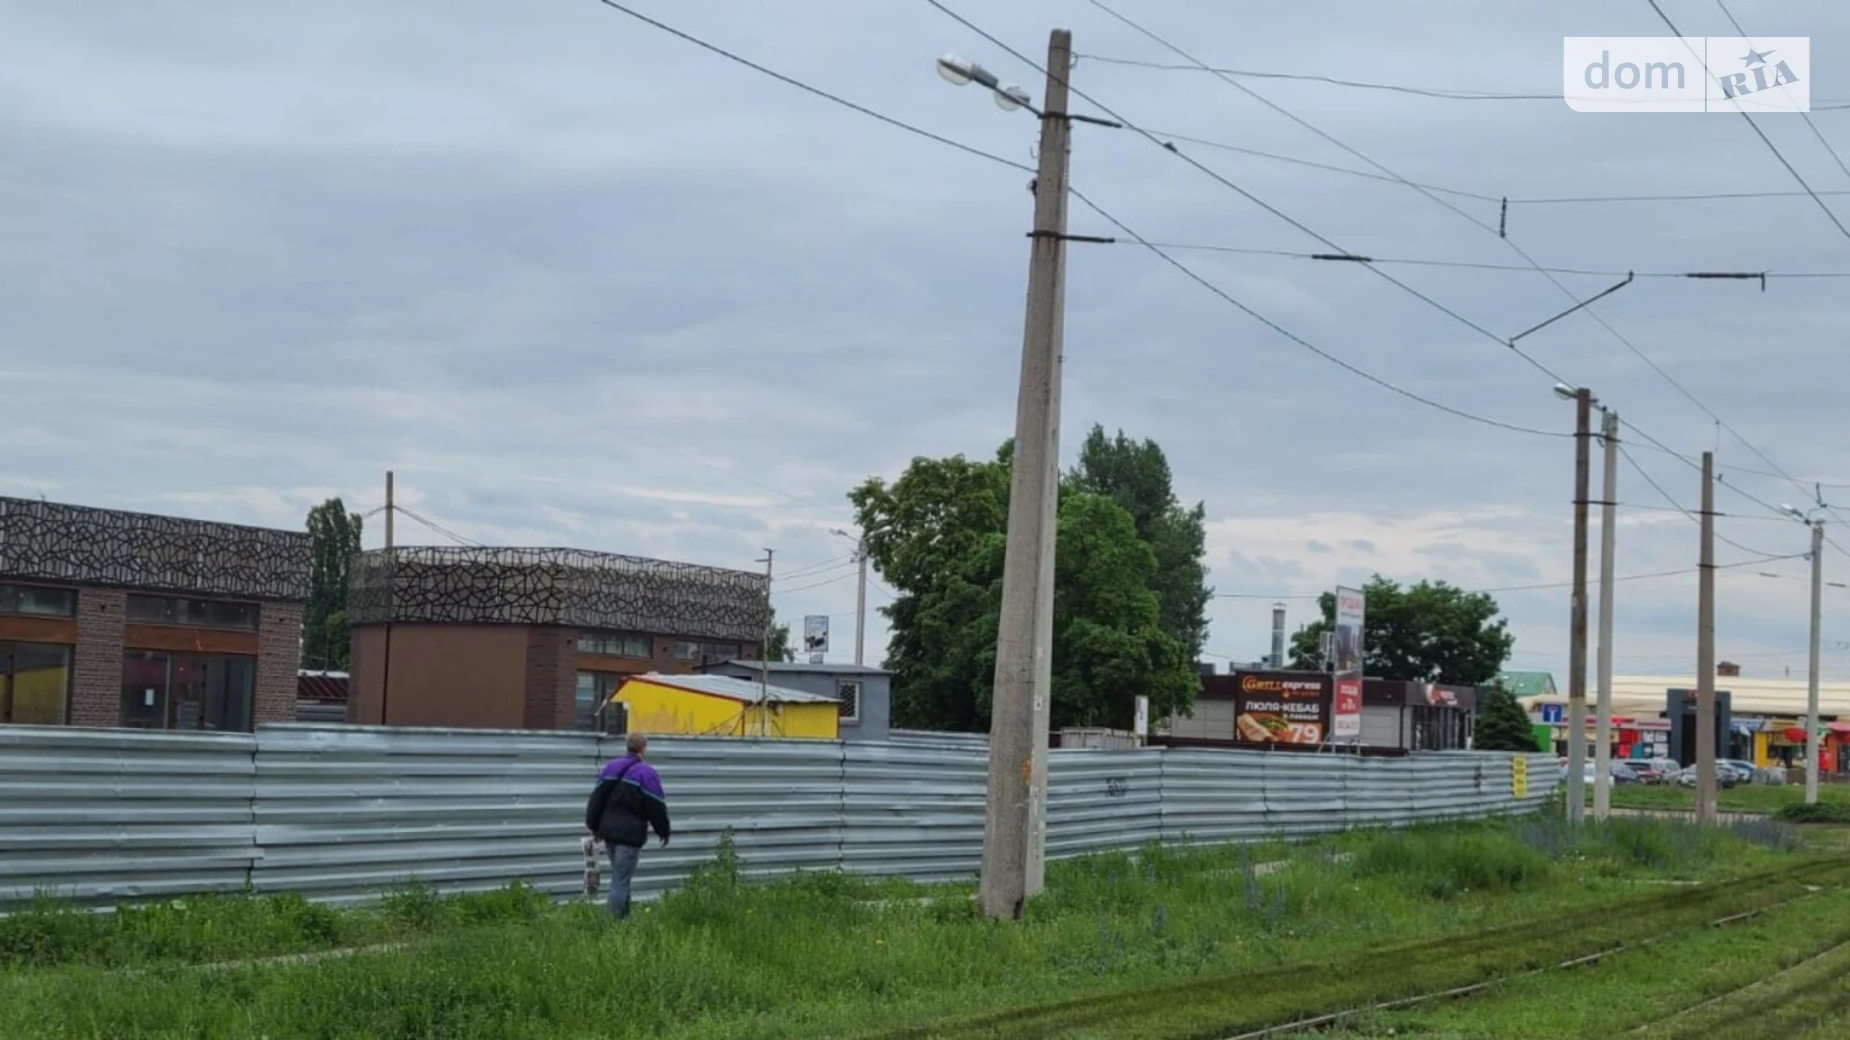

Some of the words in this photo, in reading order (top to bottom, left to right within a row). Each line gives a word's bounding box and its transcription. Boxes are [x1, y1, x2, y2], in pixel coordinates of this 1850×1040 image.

[1281, 681, 1322, 691] express
[1244, 701, 1320, 713] ЛЮЛЯ-КЕБАБ
[1288, 723, 1321, 744] 79
